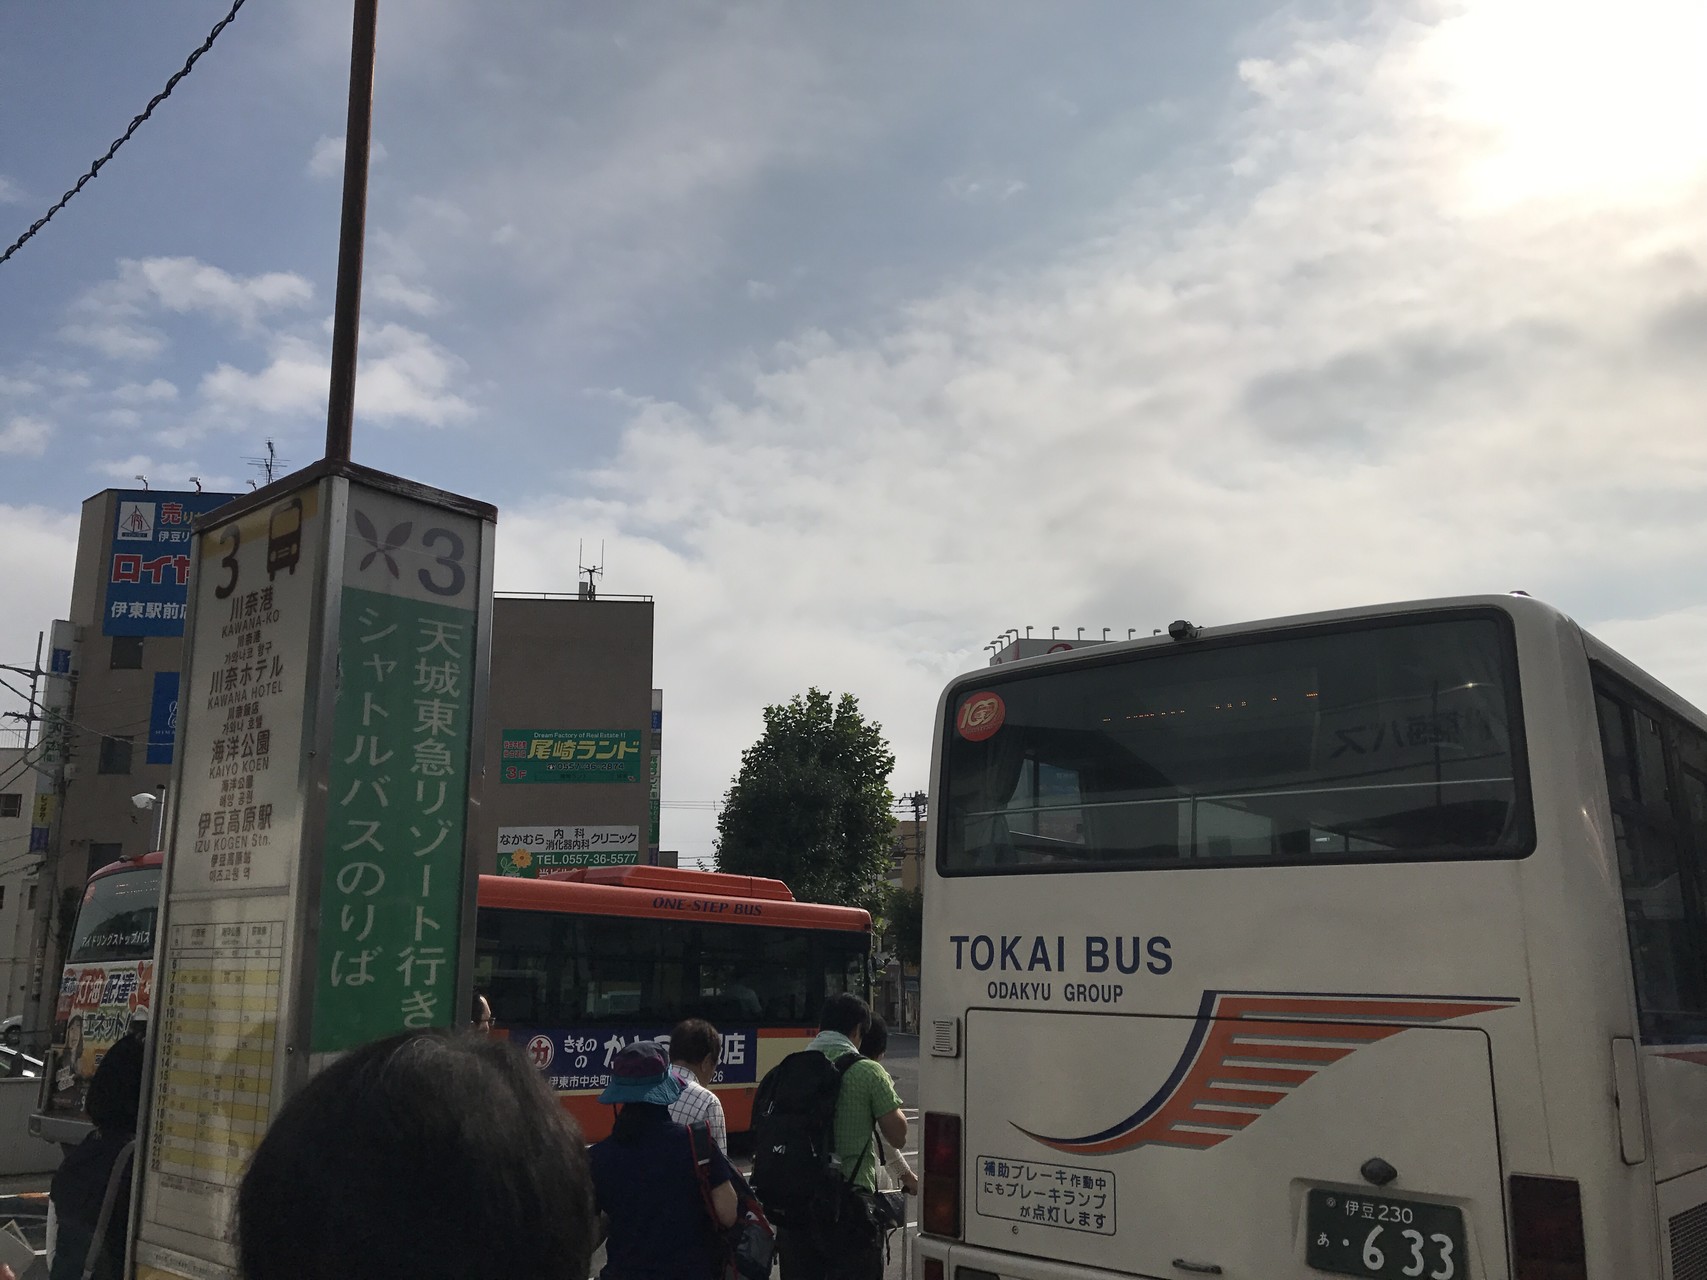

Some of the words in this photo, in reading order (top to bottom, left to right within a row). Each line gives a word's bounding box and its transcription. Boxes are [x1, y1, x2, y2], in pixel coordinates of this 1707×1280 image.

[215, 524, 240, 599] 3
[418, 527, 465, 596] 3
[230, 585, 273, 622] 川奈港
[222, 609, 280, 638] KAWANA-KO
[210, 654, 283, 695] 川奈ホテル
[207, 688, 247, 710] KAWANA
[251, 680, 283, 699] HOTEL
[211, 729, 270, 764] 海洋公園
[527, 739, 639, 761] 尾崎ランド
[209, 762, 238, 779] KAIYO
[242, 756, 269, 774] KOEN
[330, 607, 398, 987] シャトルバスのりば
[198, 804, 273, 838] 伊豆高原駅
[396, 618, 463, 1030] 天城東急リゾート行き
[194, 839, 210, 853] IZU
[214, 835, 248, 851] KOGEN
[500, 834, 545, 845] なかむら
[546, 839, 590, 850] 消化器内科
[591, 832, 637, 844] クリニック
[733, 903, 763, 916] BUS
[950, 935, 1065, 972] TOKAI
[1086, 936, 1173, 975] BUS
[987, 981, 1051, 1001] ODAKYU
[1064, 983, 1123, 1003] GROUP
[563, 1038, 597, 1054] きもの
[574, 1055, 588, 1069] の
[984, 1160, 1106, 1190] 補助ブレーキ作動中
[984, 1182, 1107, 1209] にもブレーキランプ
[1020, 1204, 1106, 1229] が点灯します
[1317, 1232, 1330, 1247] あ
